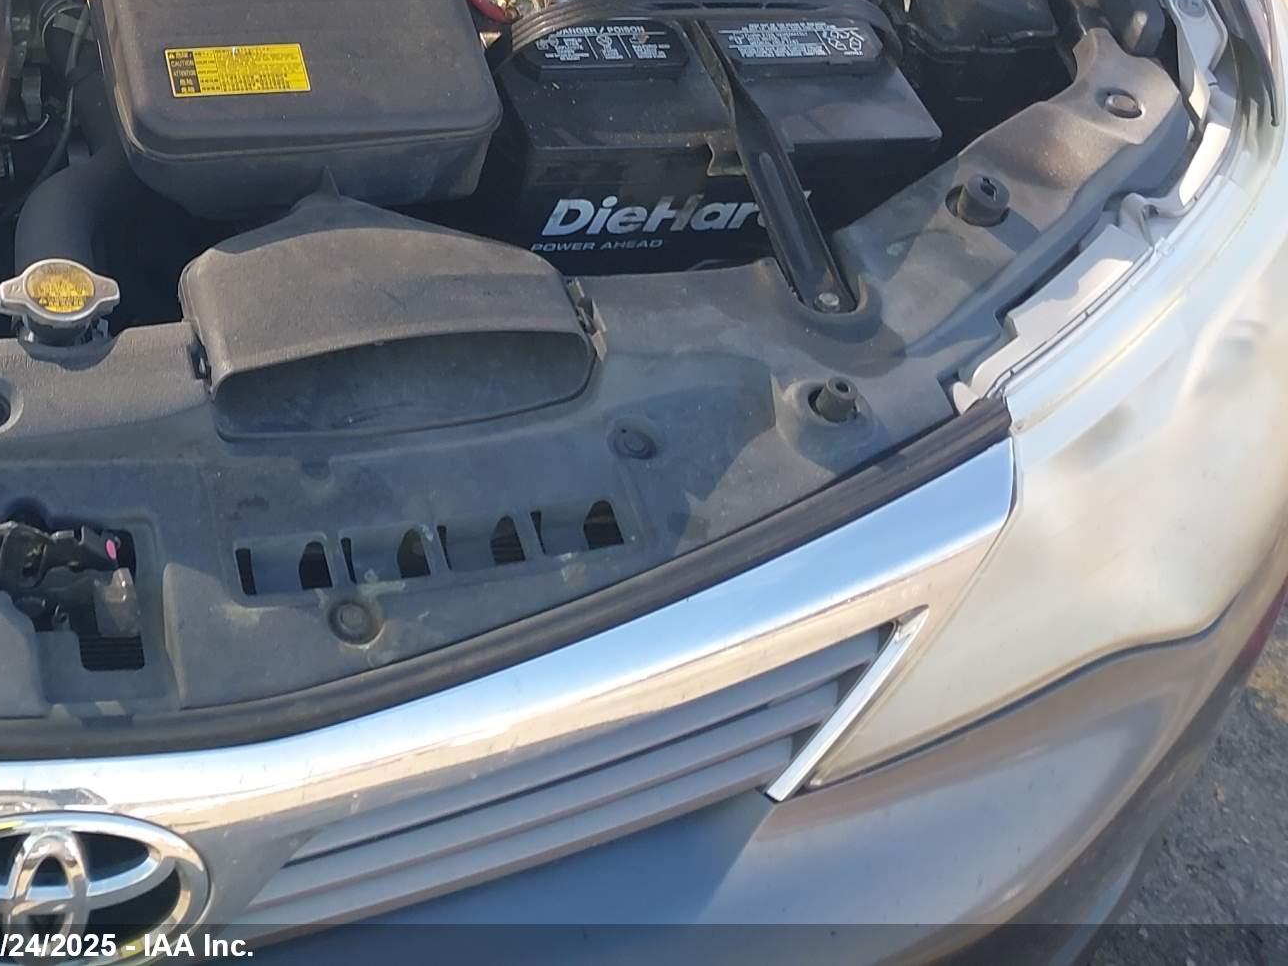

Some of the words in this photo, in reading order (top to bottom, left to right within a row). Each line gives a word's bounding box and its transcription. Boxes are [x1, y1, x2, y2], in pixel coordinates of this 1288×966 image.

[541, 193, 766, 236] DieHar
[530, 241, 596, 252] POWER
[599, 239, 664, 251] AHEAD
